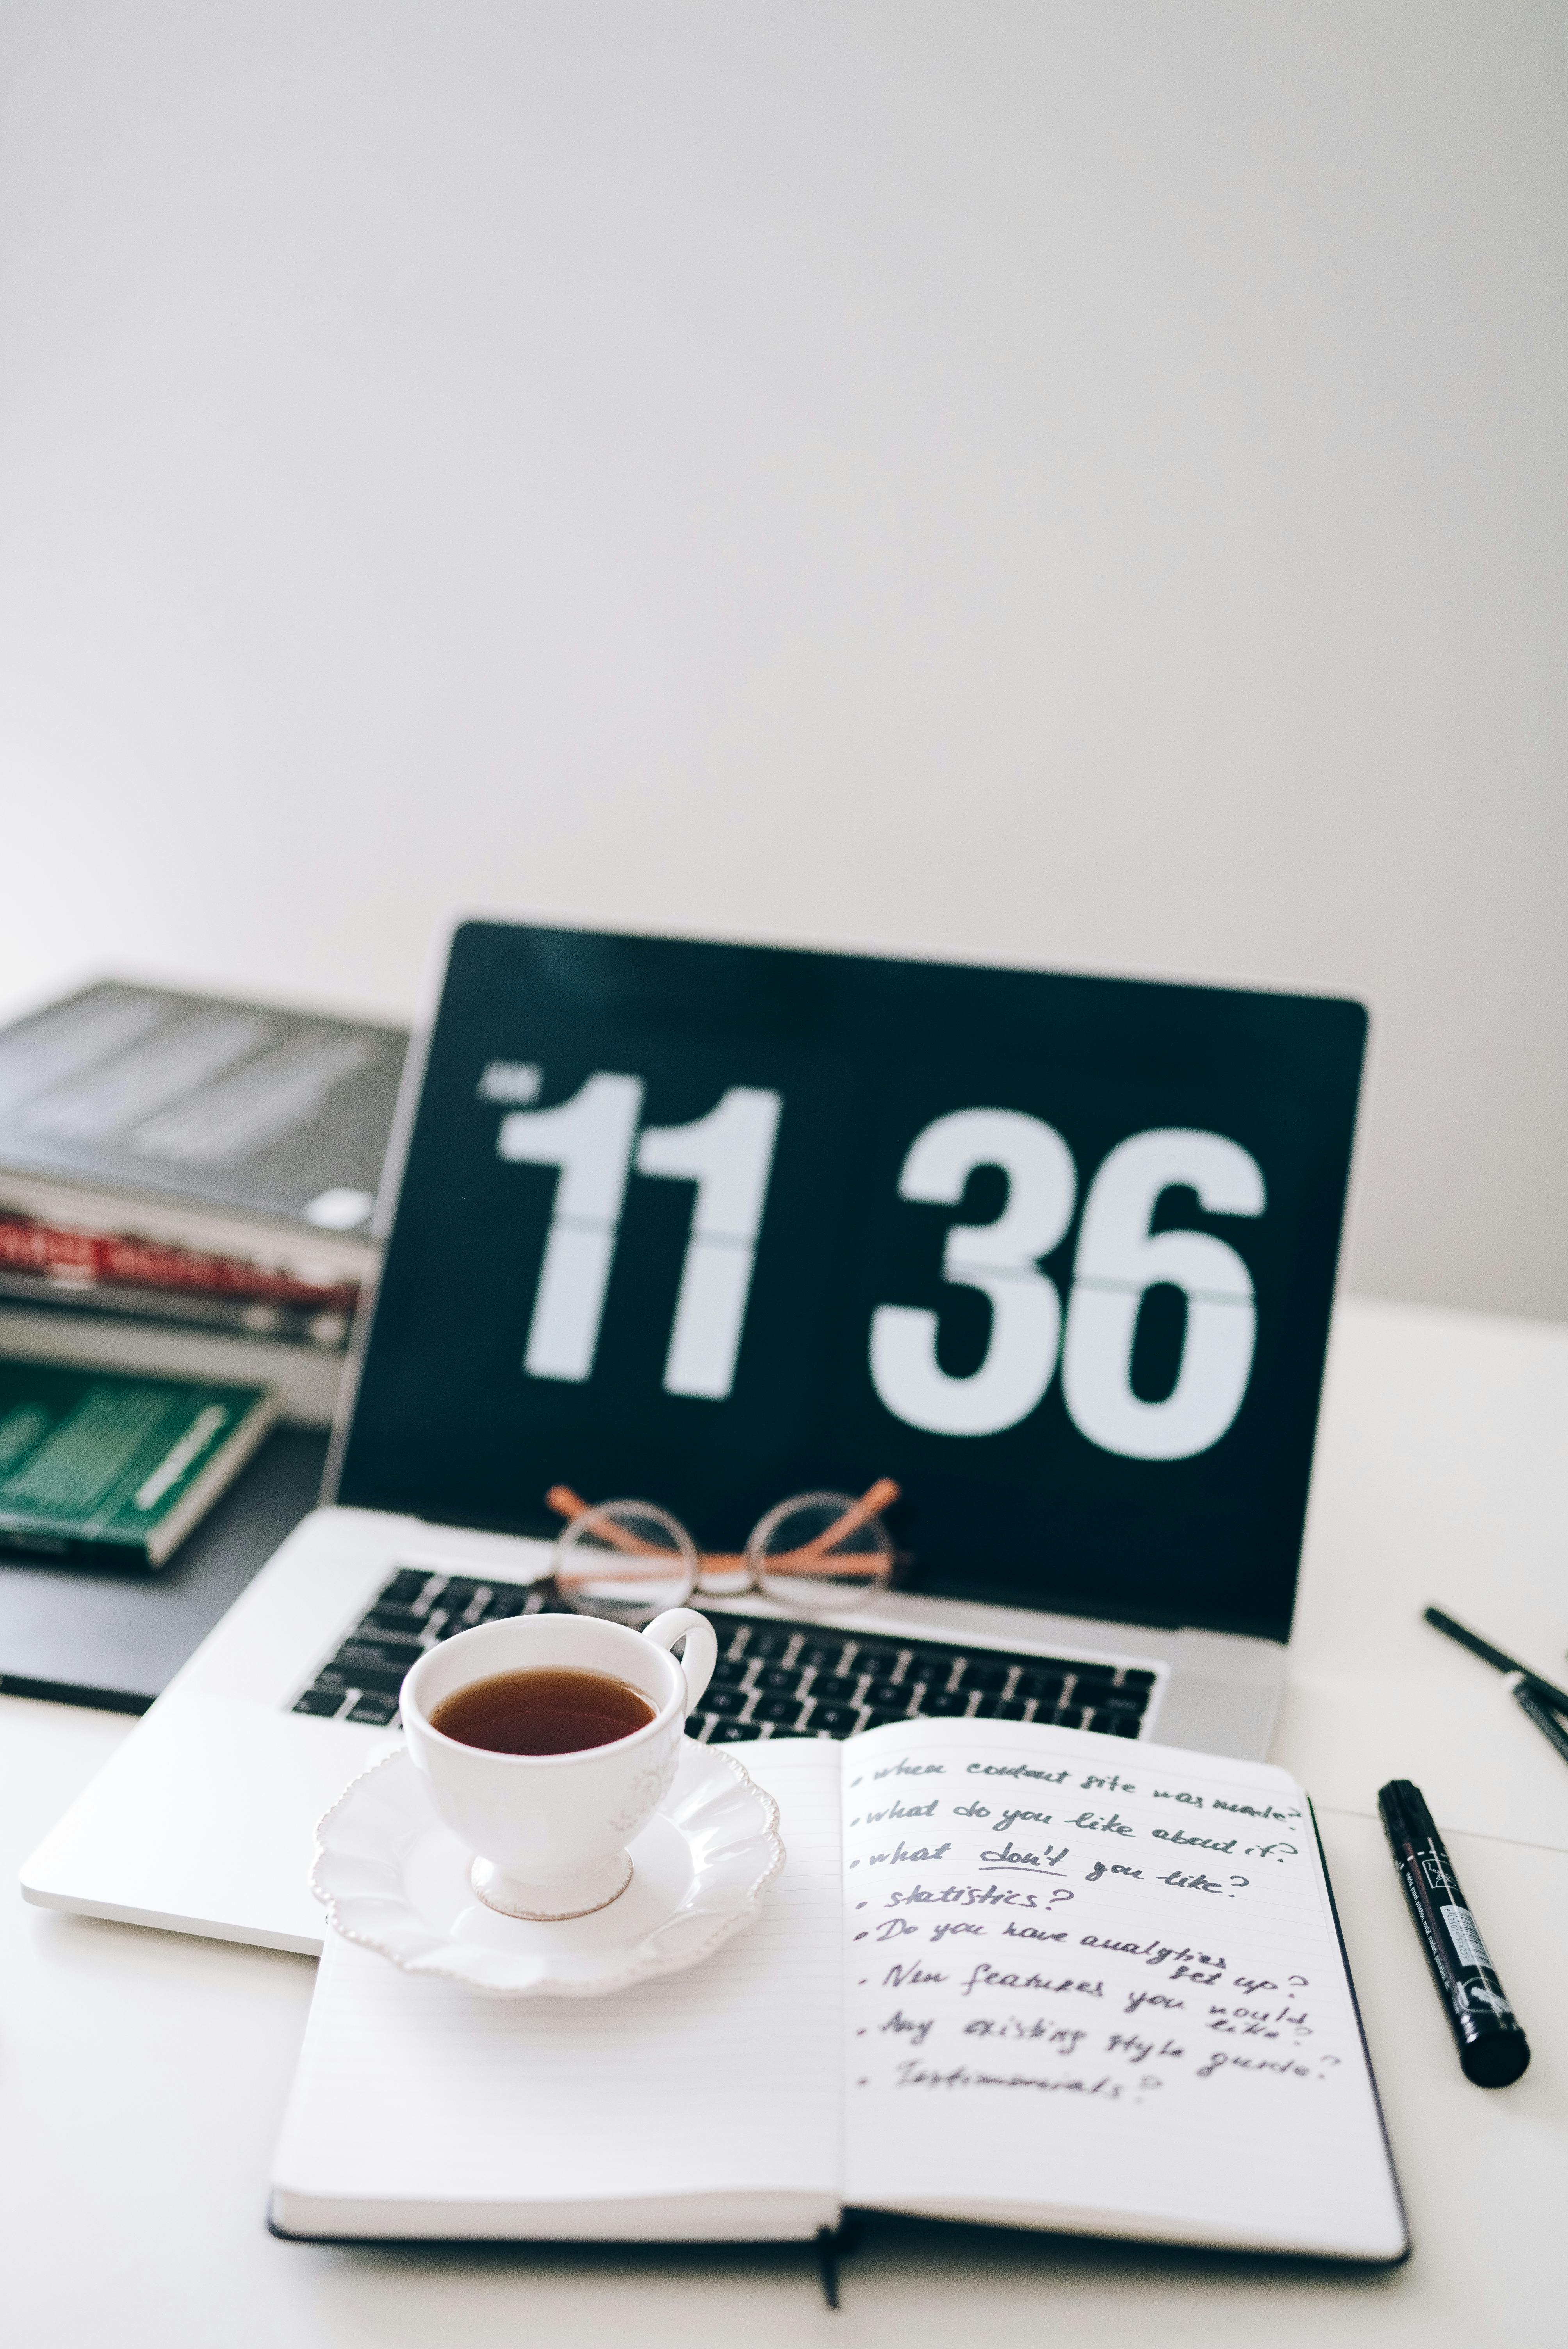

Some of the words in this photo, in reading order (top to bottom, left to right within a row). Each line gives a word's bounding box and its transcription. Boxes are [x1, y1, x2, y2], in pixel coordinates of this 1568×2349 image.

[498, 1071, 782, 1401] 11
[870, 1107, 1266, 1460] 36
[874, 1758, 945, 1780] when
[1080, 1775, 1136, 1793] site
[1152, 1790, 1204, 1809] was
[866, 1799, 939, 1823] what
[953, 1800, 991, 1818] do
[992, 1809, 1053, 1832] you
[1064, 1812, 1136, 1837] like
[1151, 1829, 1238, 1854] about
[1244, 1842, 1299, 1863] it?
[870, 1841, 951, 1865] what
[980, 1841, 1069, 1867] don't
[1085, 1861, 1144, 1882] you
[1156, 1870, 1250, 1898] like?
[876, 1918, 918, 1942] Do
[929, 1923, 986, 1942] you
[1002, 1921, 1069, 1943] have
[1079, 1935, 1227, 1970] analytics
[882, 1960, 948, 1988] New
[961, 1963, 1104, 1998] features
[1123, 1991, 1185, 2014] you
[1208, 2006, 1309, 2025] would
[1168, 1965, 1222, 1986] set
[962, 2017, 1087, 2056] existing
[1105, 2034, 1185, 2064] style
